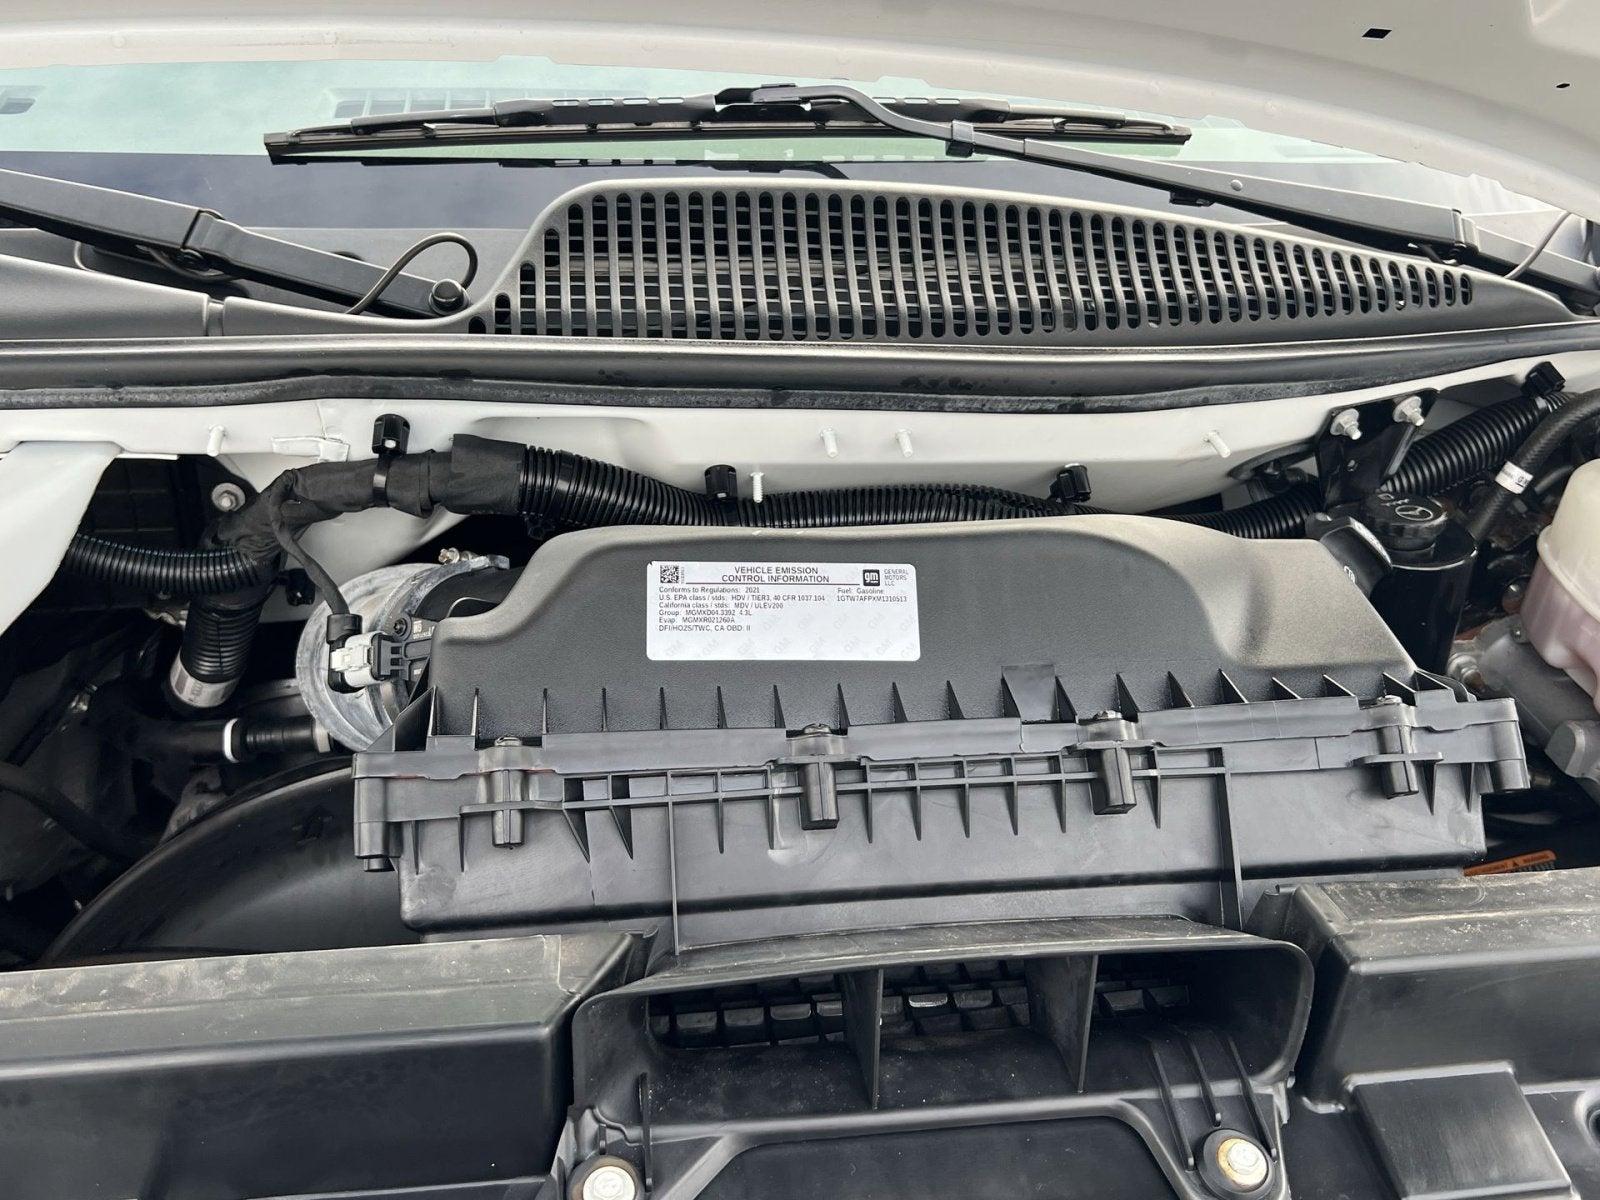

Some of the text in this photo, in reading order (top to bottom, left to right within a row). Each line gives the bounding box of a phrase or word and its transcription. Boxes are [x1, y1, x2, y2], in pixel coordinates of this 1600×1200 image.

[734, 566, 819, 574] VEHICLE EMISSION
[721, 574, 829, 583] CONTROL INFORMATION
[701, 586, 741, 595] Regulations:
[659, 601, 691, 609] California
[754, 602, 784, 610] ULEV200
[659, 609, 682, 617] Group:
